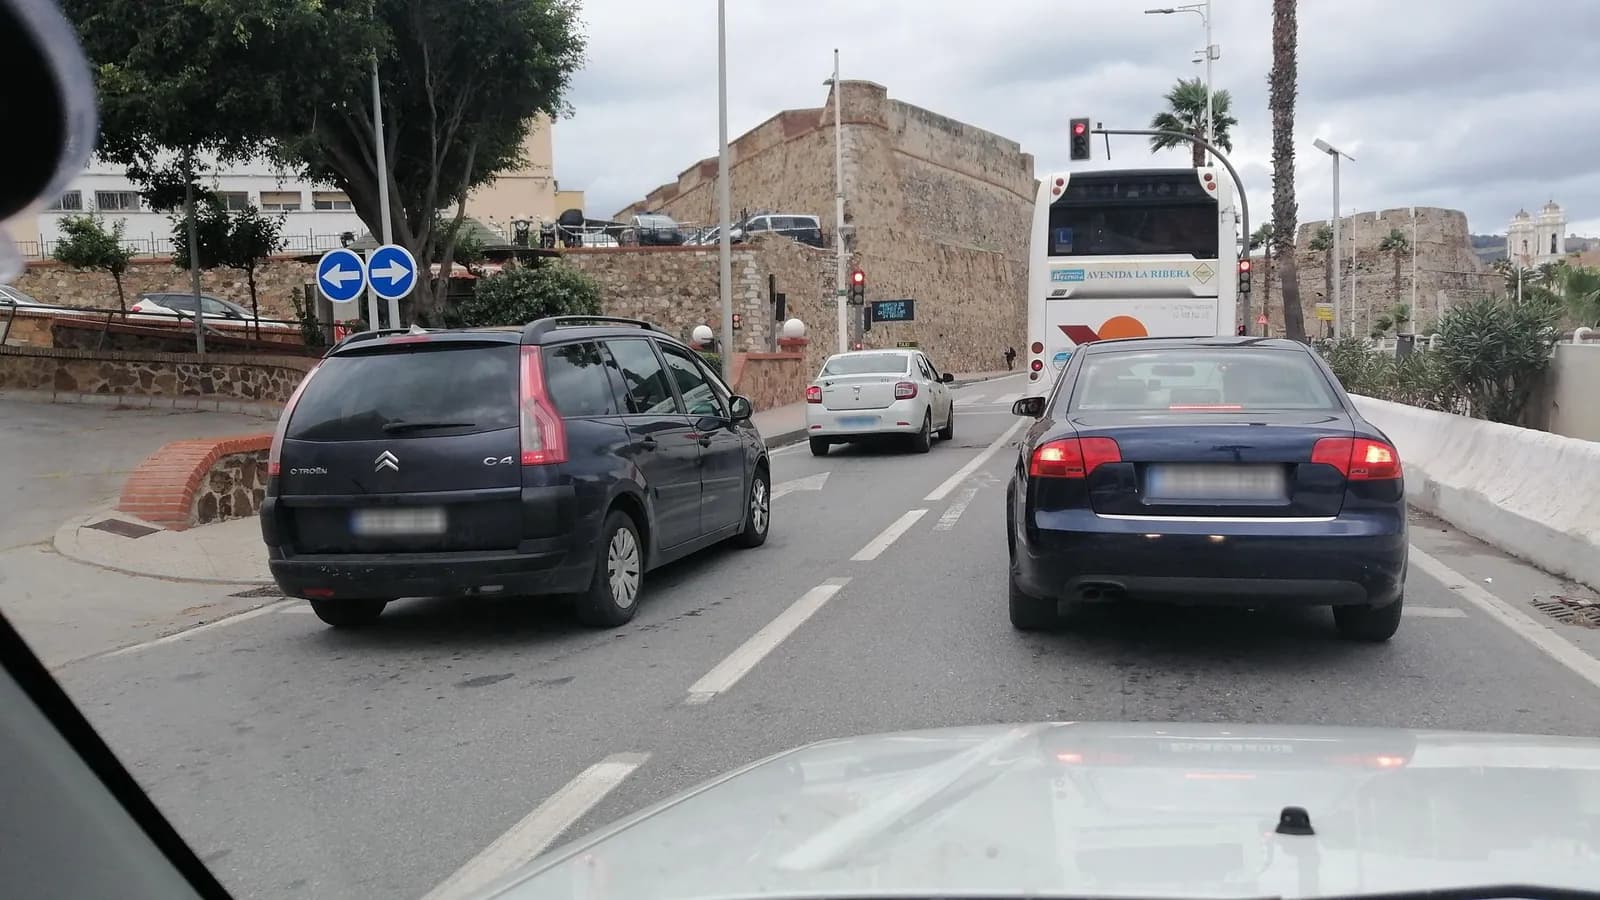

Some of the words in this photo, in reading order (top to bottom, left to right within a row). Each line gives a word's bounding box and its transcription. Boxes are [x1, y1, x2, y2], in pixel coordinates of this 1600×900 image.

[1087, 270, 1133, 279] AVENIDA
[1135, 270, 1148, 279] LA
[1151, 269, 1191, 278] RIBERA
[483, 455, 514, 466] C4
